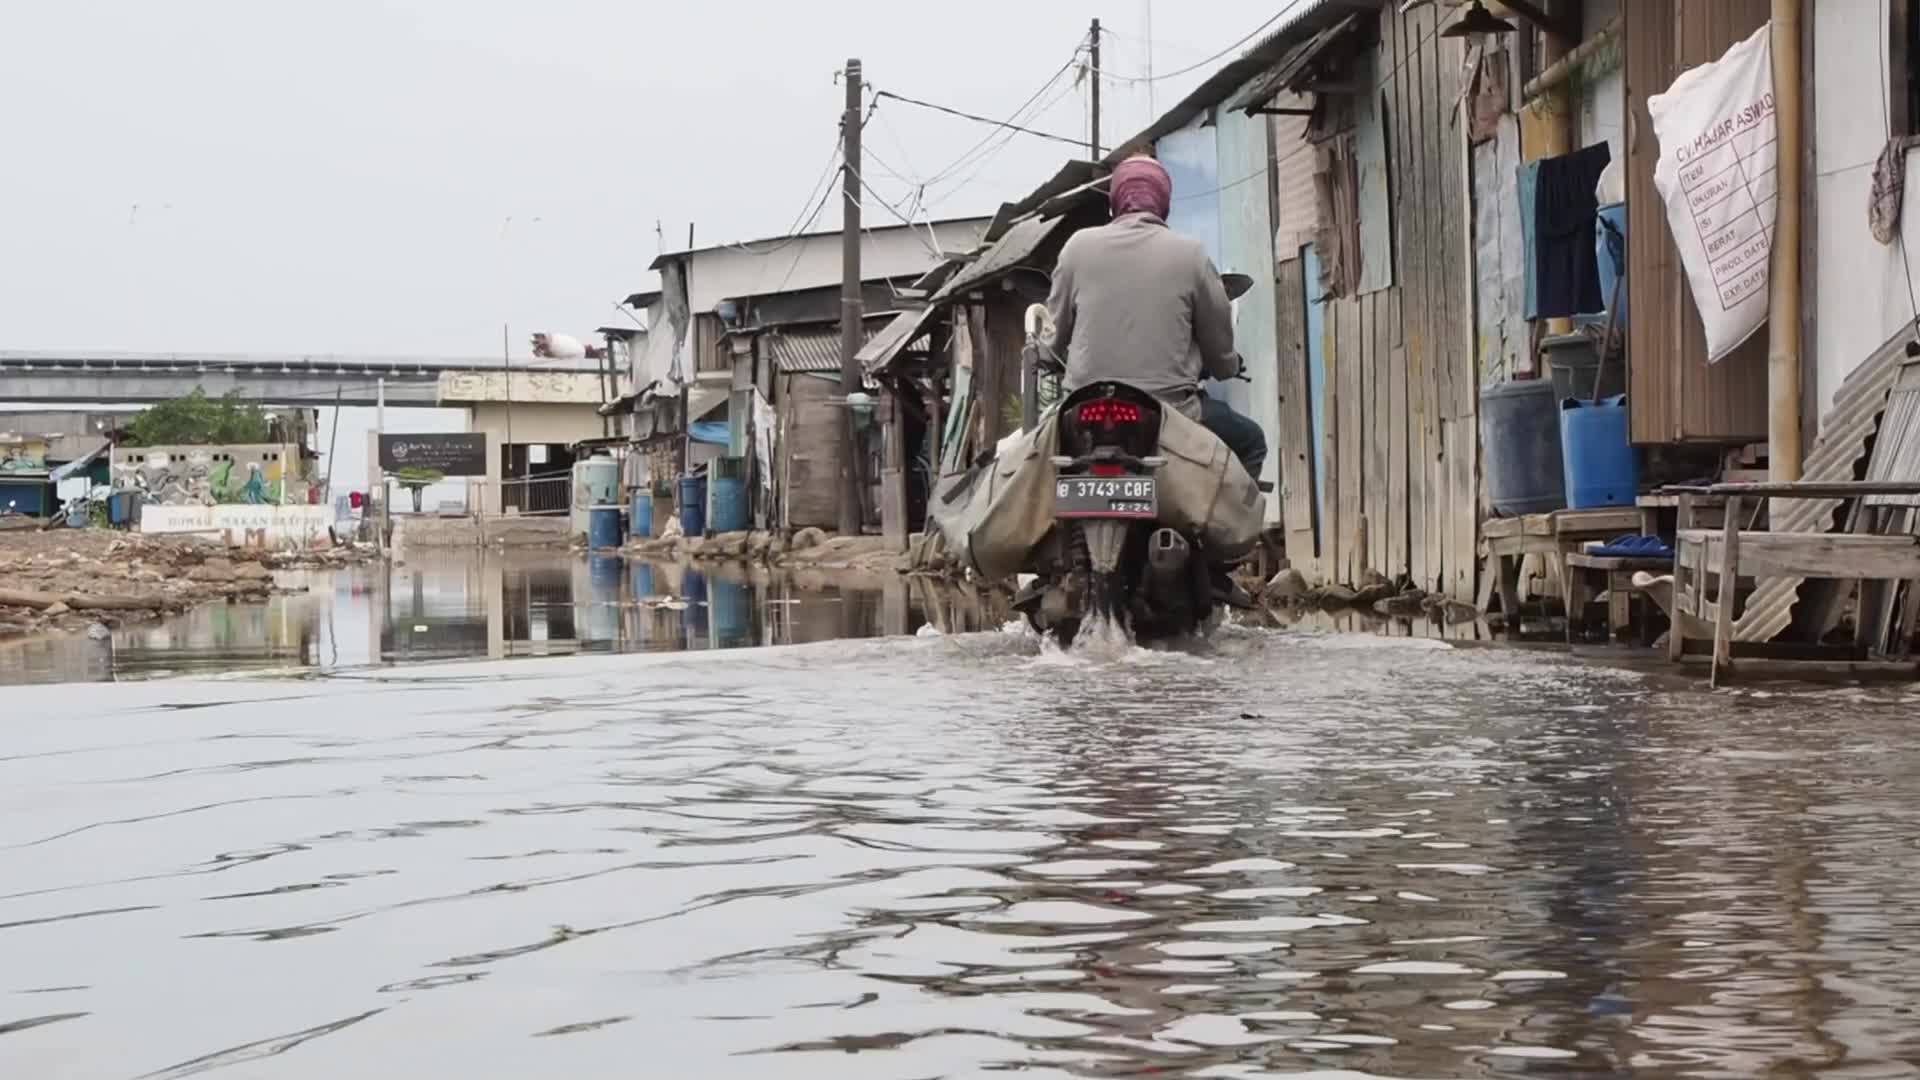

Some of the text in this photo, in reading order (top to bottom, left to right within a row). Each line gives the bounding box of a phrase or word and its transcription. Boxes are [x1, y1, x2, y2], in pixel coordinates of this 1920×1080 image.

[1736, 92, 1776, 128] ASWAD
[1682, 165, 1704, 186] ITEM
[1692, 179, 1728, 207] UKURAN
[1700, 216, 1712, 230] ISI
[1706, 229, 1737, 254] BERAT
[1744, 239, 1767, 260] DATE
[1743, 269, 1767, 290] DATE
[1077, 482, 1114, 497] 3743
